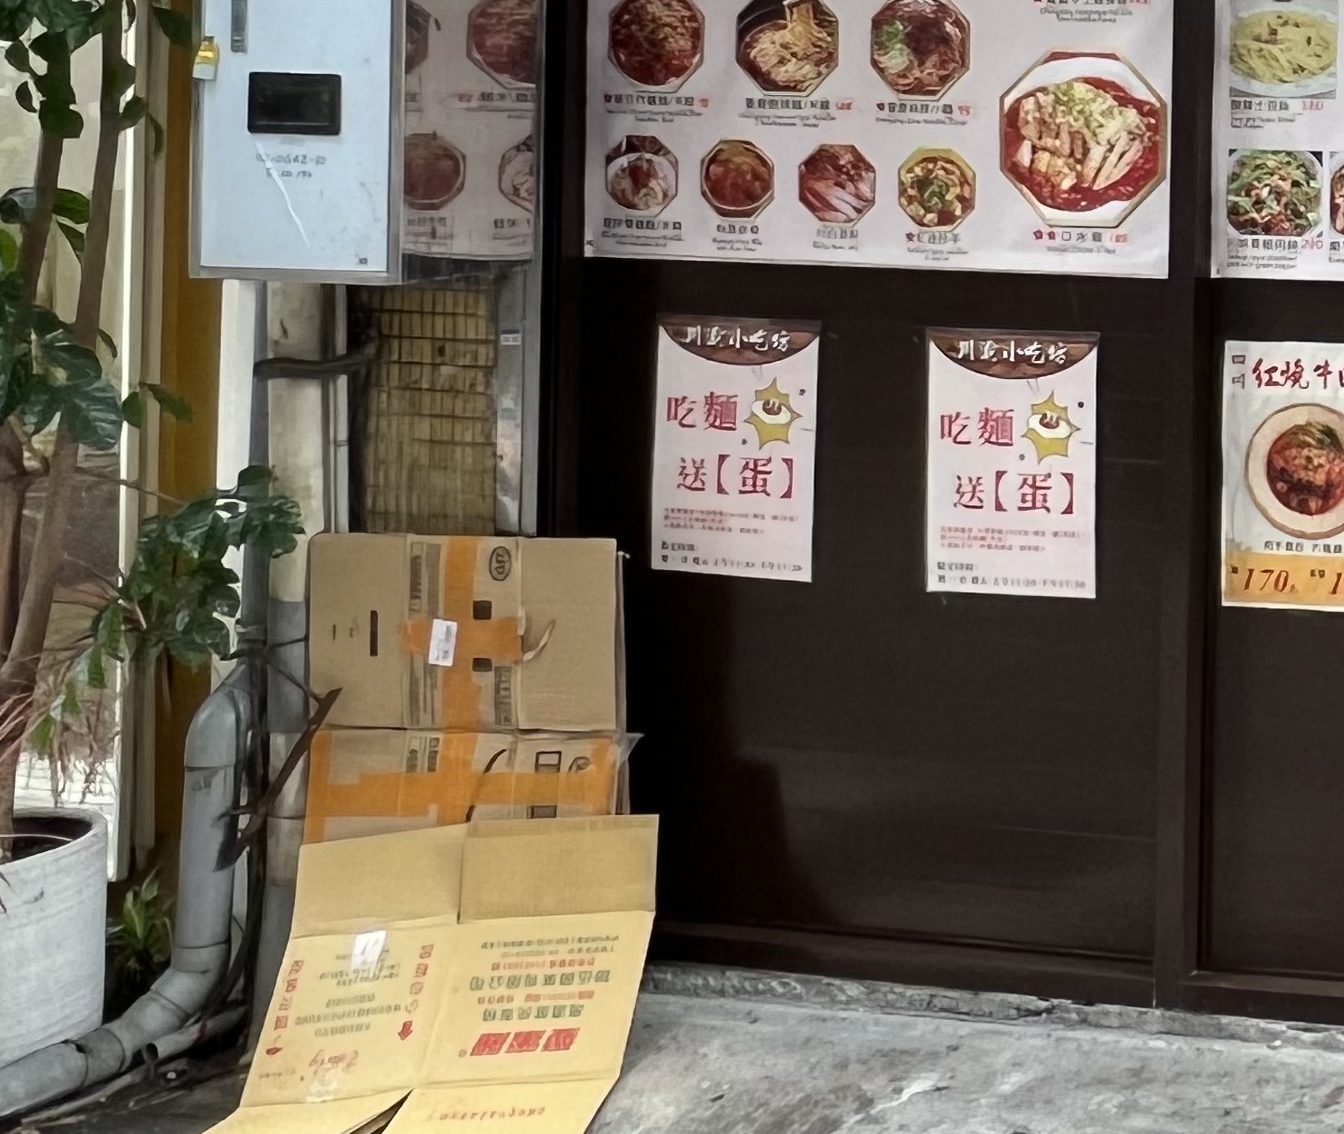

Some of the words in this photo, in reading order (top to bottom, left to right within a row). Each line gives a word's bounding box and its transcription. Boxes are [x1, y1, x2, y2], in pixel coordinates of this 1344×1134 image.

[666, 391, 739, 432] 吃麵
[939, 406, 1015, 448] 吃麵
[676, 453, 795, 500] 送【蛋】
[953, 469, 1075, 516] 送【蛋】
[1243, 568, 1290, 593] 170
